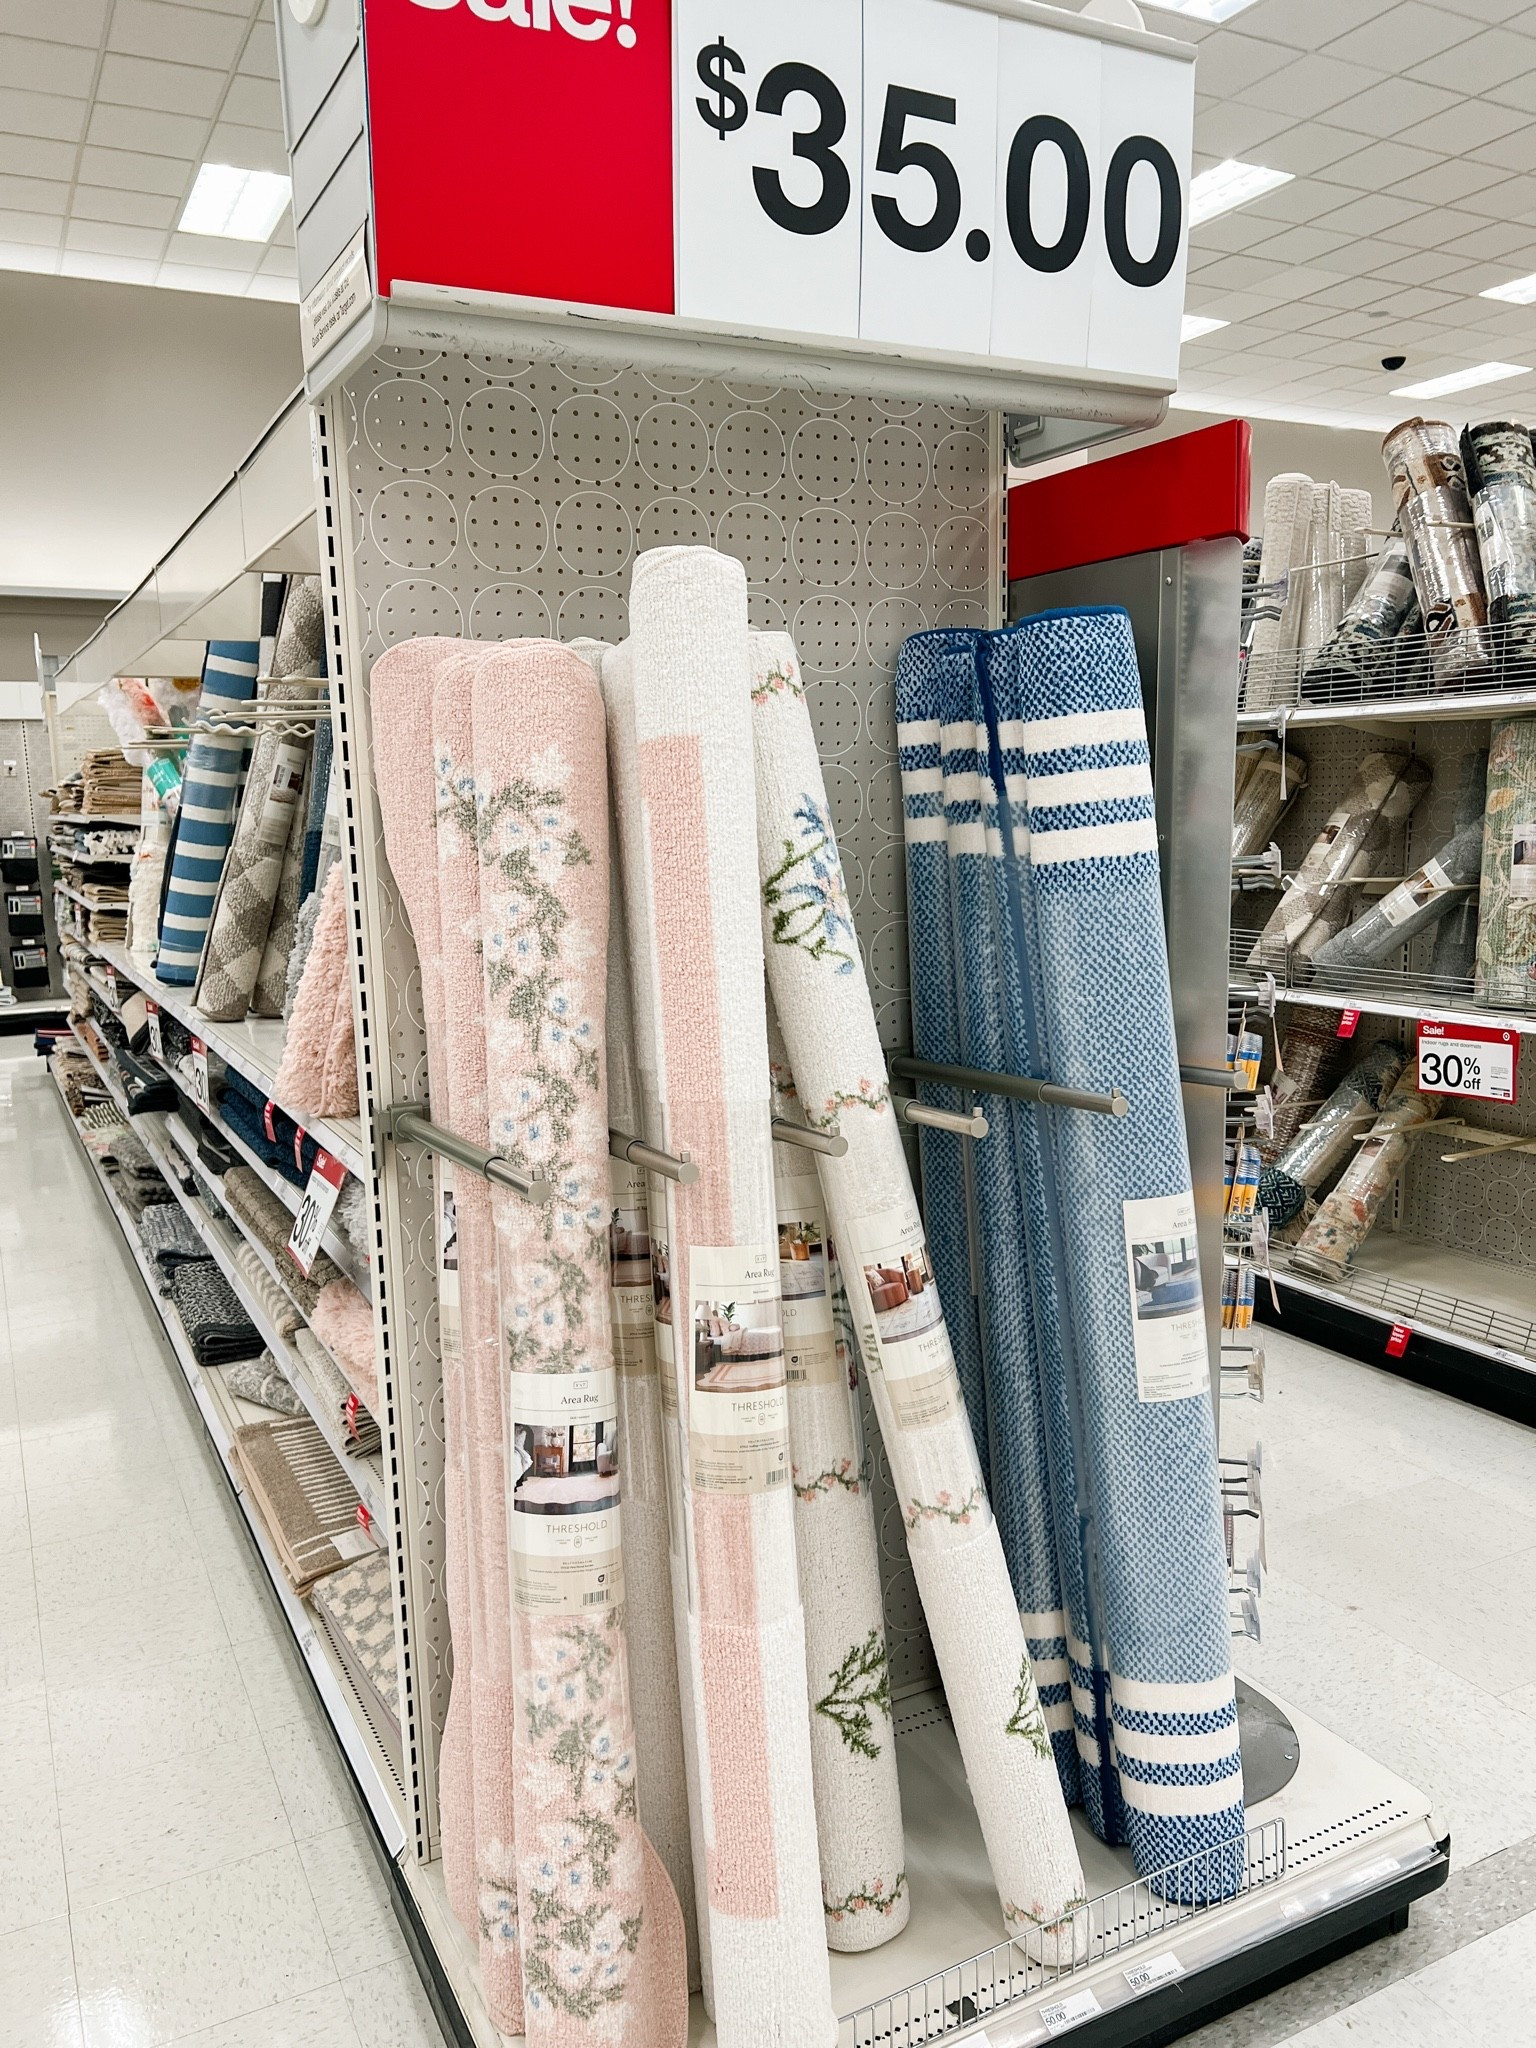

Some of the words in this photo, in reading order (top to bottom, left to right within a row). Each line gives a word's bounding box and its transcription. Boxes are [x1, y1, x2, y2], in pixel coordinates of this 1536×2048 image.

[695, 36, 1182, 289] $35.00
[1422, 1025, 1445, 1035] Sale!
[1463, 1078, 1481, 1091] off
[627, 1180, 646, 1189] Area
[1171, 1221, 1188, 1229] Area
[745, 1270, 762, 1279] Area
[763, 1268, 775, 1277] Rug
[620, 1293, 654, 1304] THRES
[560, 1395, 582, 1406] Area
[583, 1393, 600, 1404] Rug
[731, 1396, 785, 1412] THRESHOLD
[546, 1519, 609, 1534] THRESHOLD
[1129, 1972, 1151, 1988] 50.00
[1045, 2011, 1067, 2027] 50.00
